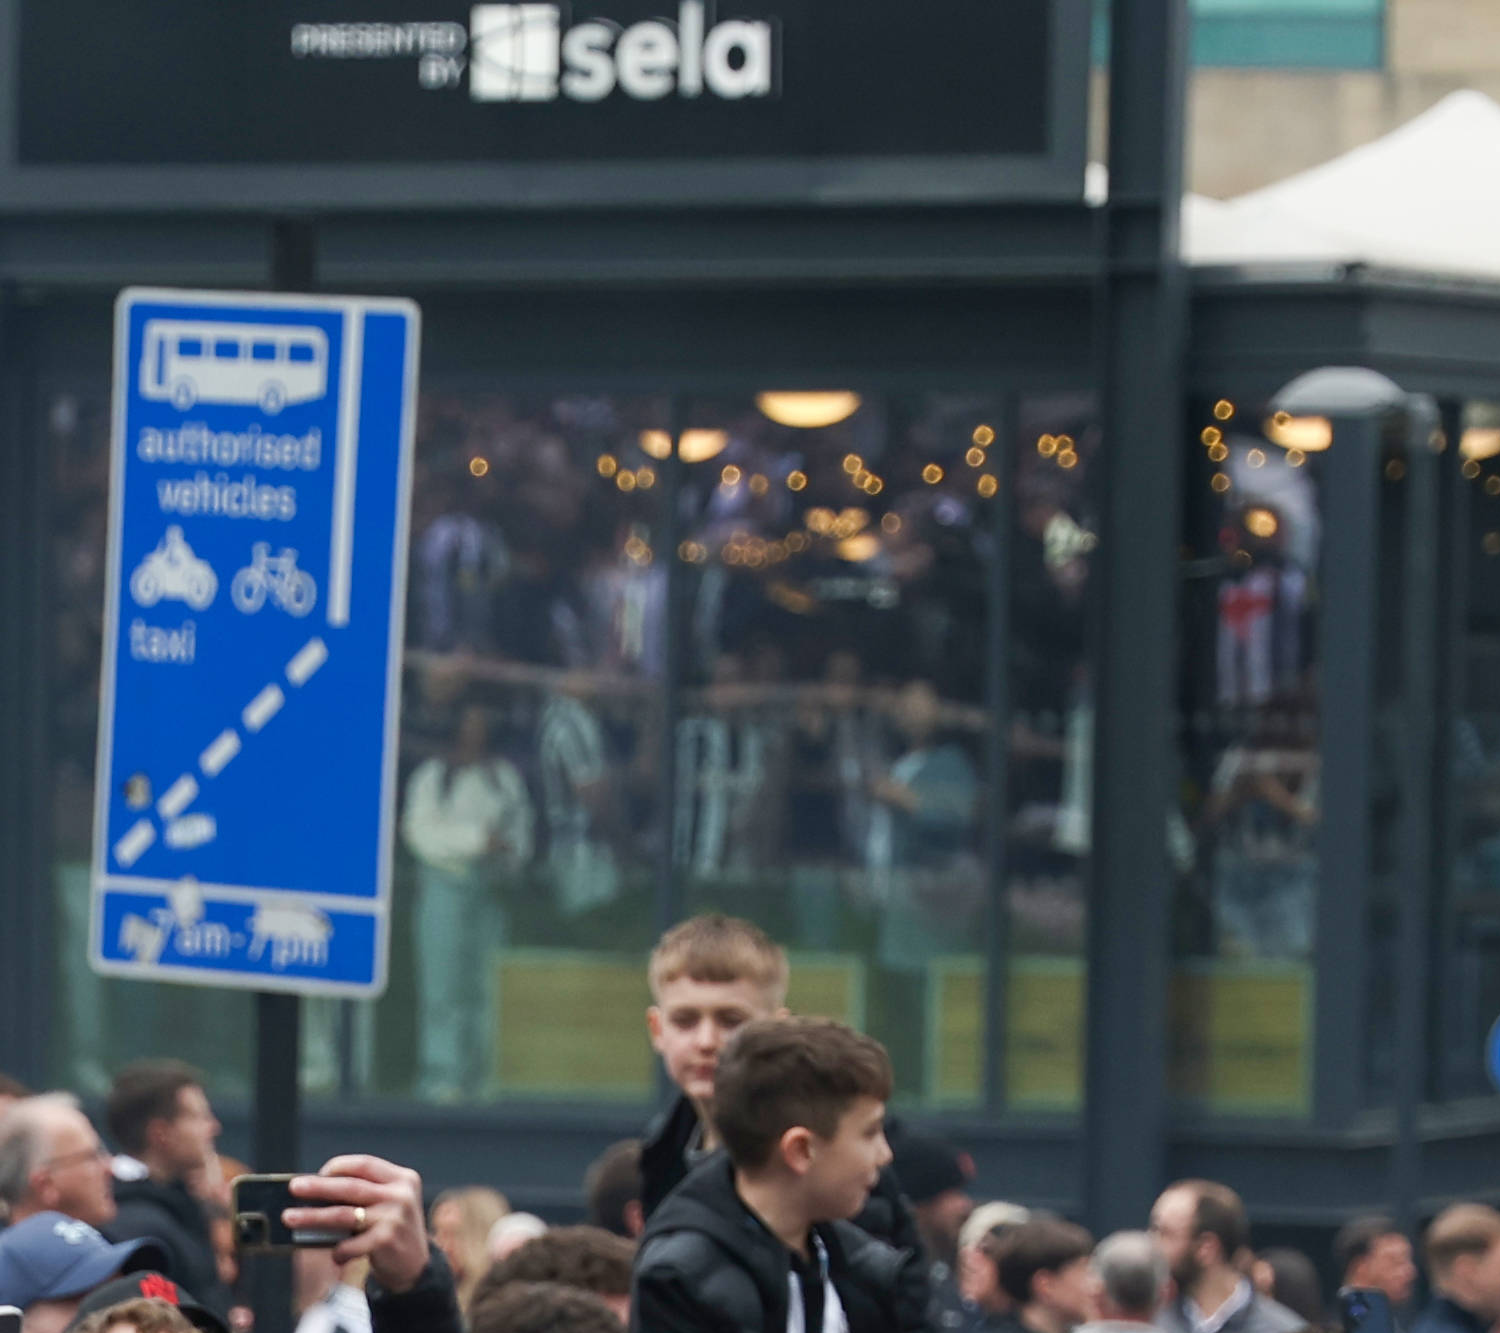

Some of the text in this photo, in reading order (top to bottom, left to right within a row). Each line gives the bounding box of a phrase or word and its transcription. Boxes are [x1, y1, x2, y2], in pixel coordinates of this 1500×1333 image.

[418, 54, 467, 90] BY
[562, 0, 772, 99] sela
[137, 421, 322, 471] authorised
[157, 470, 296, 521] vehicles
[129, 617, 196, 664] taxi
